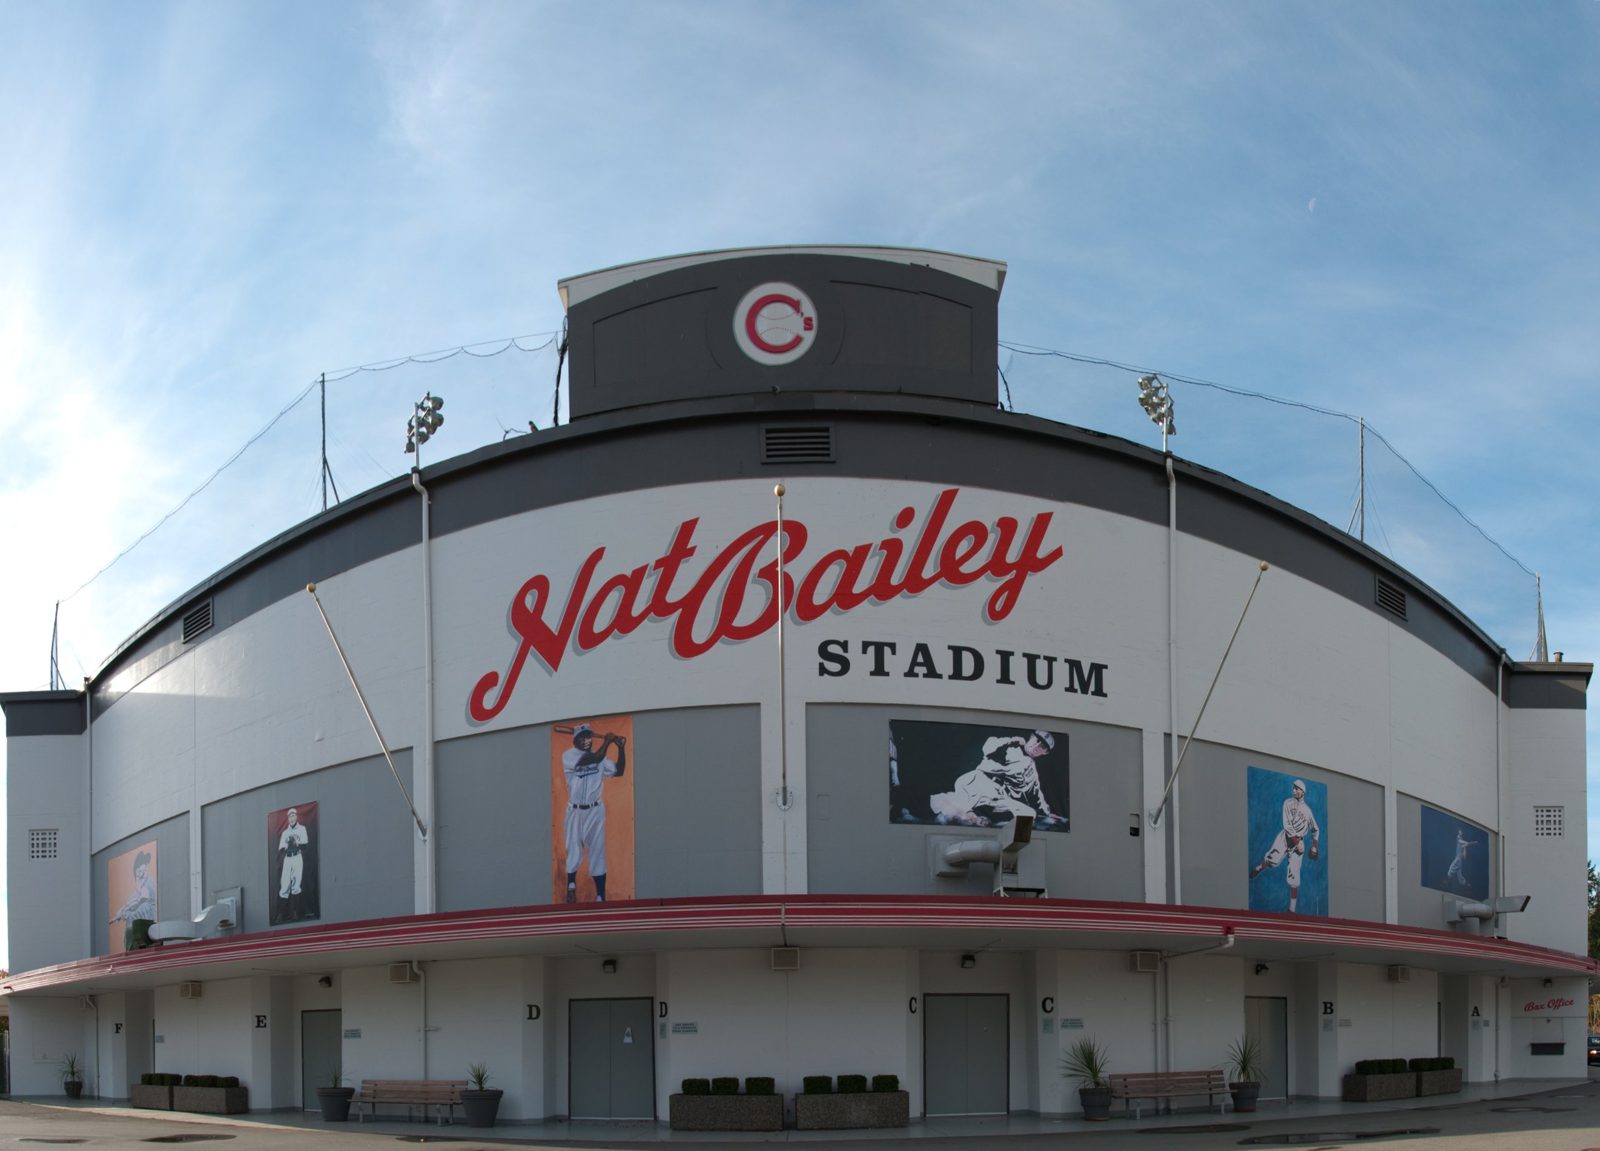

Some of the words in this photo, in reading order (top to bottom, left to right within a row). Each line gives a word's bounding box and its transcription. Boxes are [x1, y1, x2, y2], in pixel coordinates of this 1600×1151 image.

[470, 516, 701, 722] Nat
[673, 487, 1064, 660] Bailey
[818, 638, 1109, 699] STADIUM
[526, 1004, 541, 1020] D
[659, 1001, 668, 1018] D
[909, 996, 917, 1014] C
[1041, 996, 1054, 1014] C
[1322, 1001, 1334, 1015] B
[1471, 1005, 1480, 1017] A
[1524, 1001, 1546, 1013] Box
[1547, 998, 1575, 1010] Office
[114, 1022, 123, 1034] F
[255, 1014, 267, 1028] E
